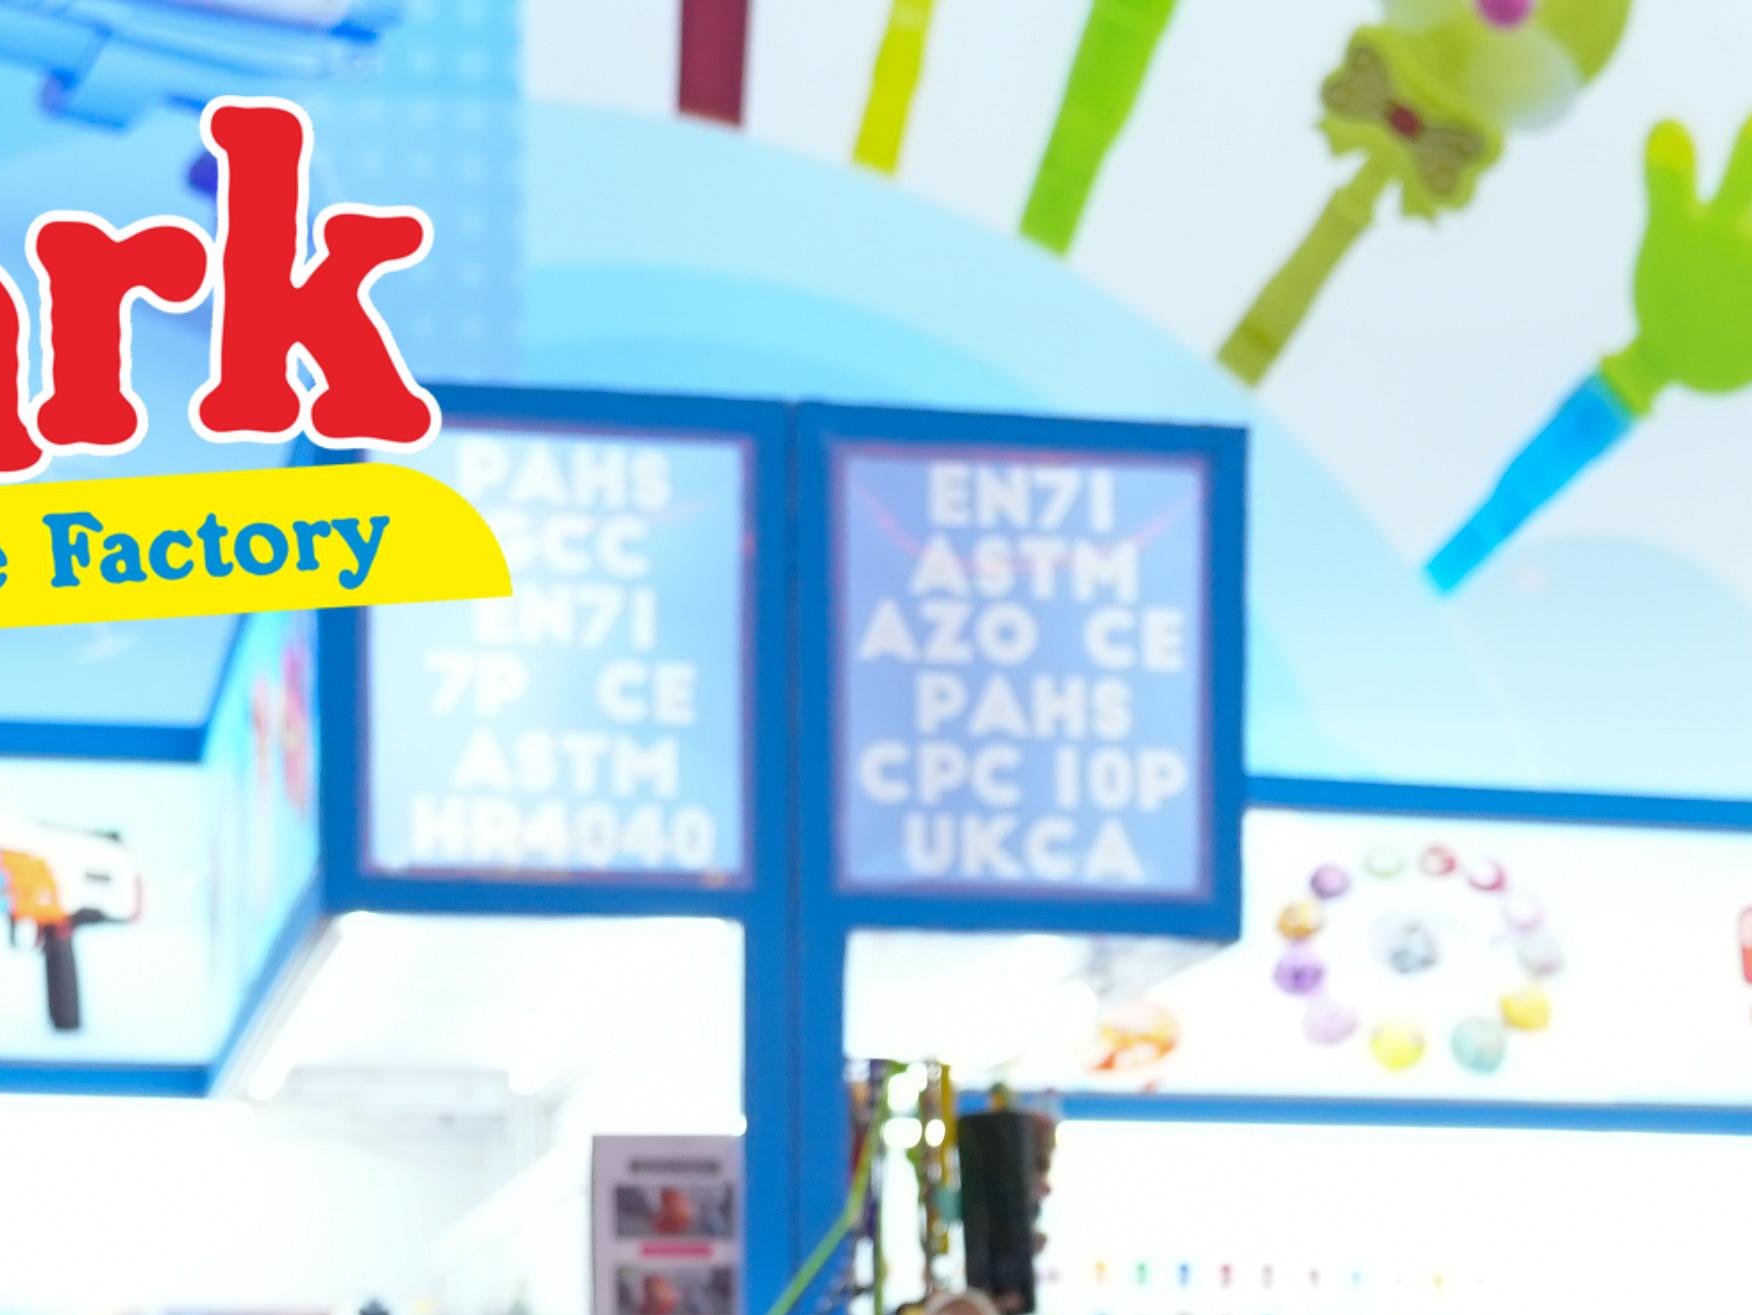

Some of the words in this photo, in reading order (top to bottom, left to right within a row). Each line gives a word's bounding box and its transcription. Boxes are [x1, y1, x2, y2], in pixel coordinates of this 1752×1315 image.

[456, 440, 672, 510] PAHS
[930, 463, 1112, 532] EN71
[912, 537, 1137, 604] ASTM
[860, 603, 1036, 664] AZO
[1086, 609, 1185, 671] CE
[424, 650, 529, 718] 7P
[597, 662, 697, 726] CE
[916, 675, 1131, 741] PAHS
[452, 727, 681, 797] ASTM
[860, 742, 1022, 806] CPC
[1058, 750, 1187, 813] 10P
[409, 793, 716, 868] HR4040
[904, 814, 1142, 881] UKCA
